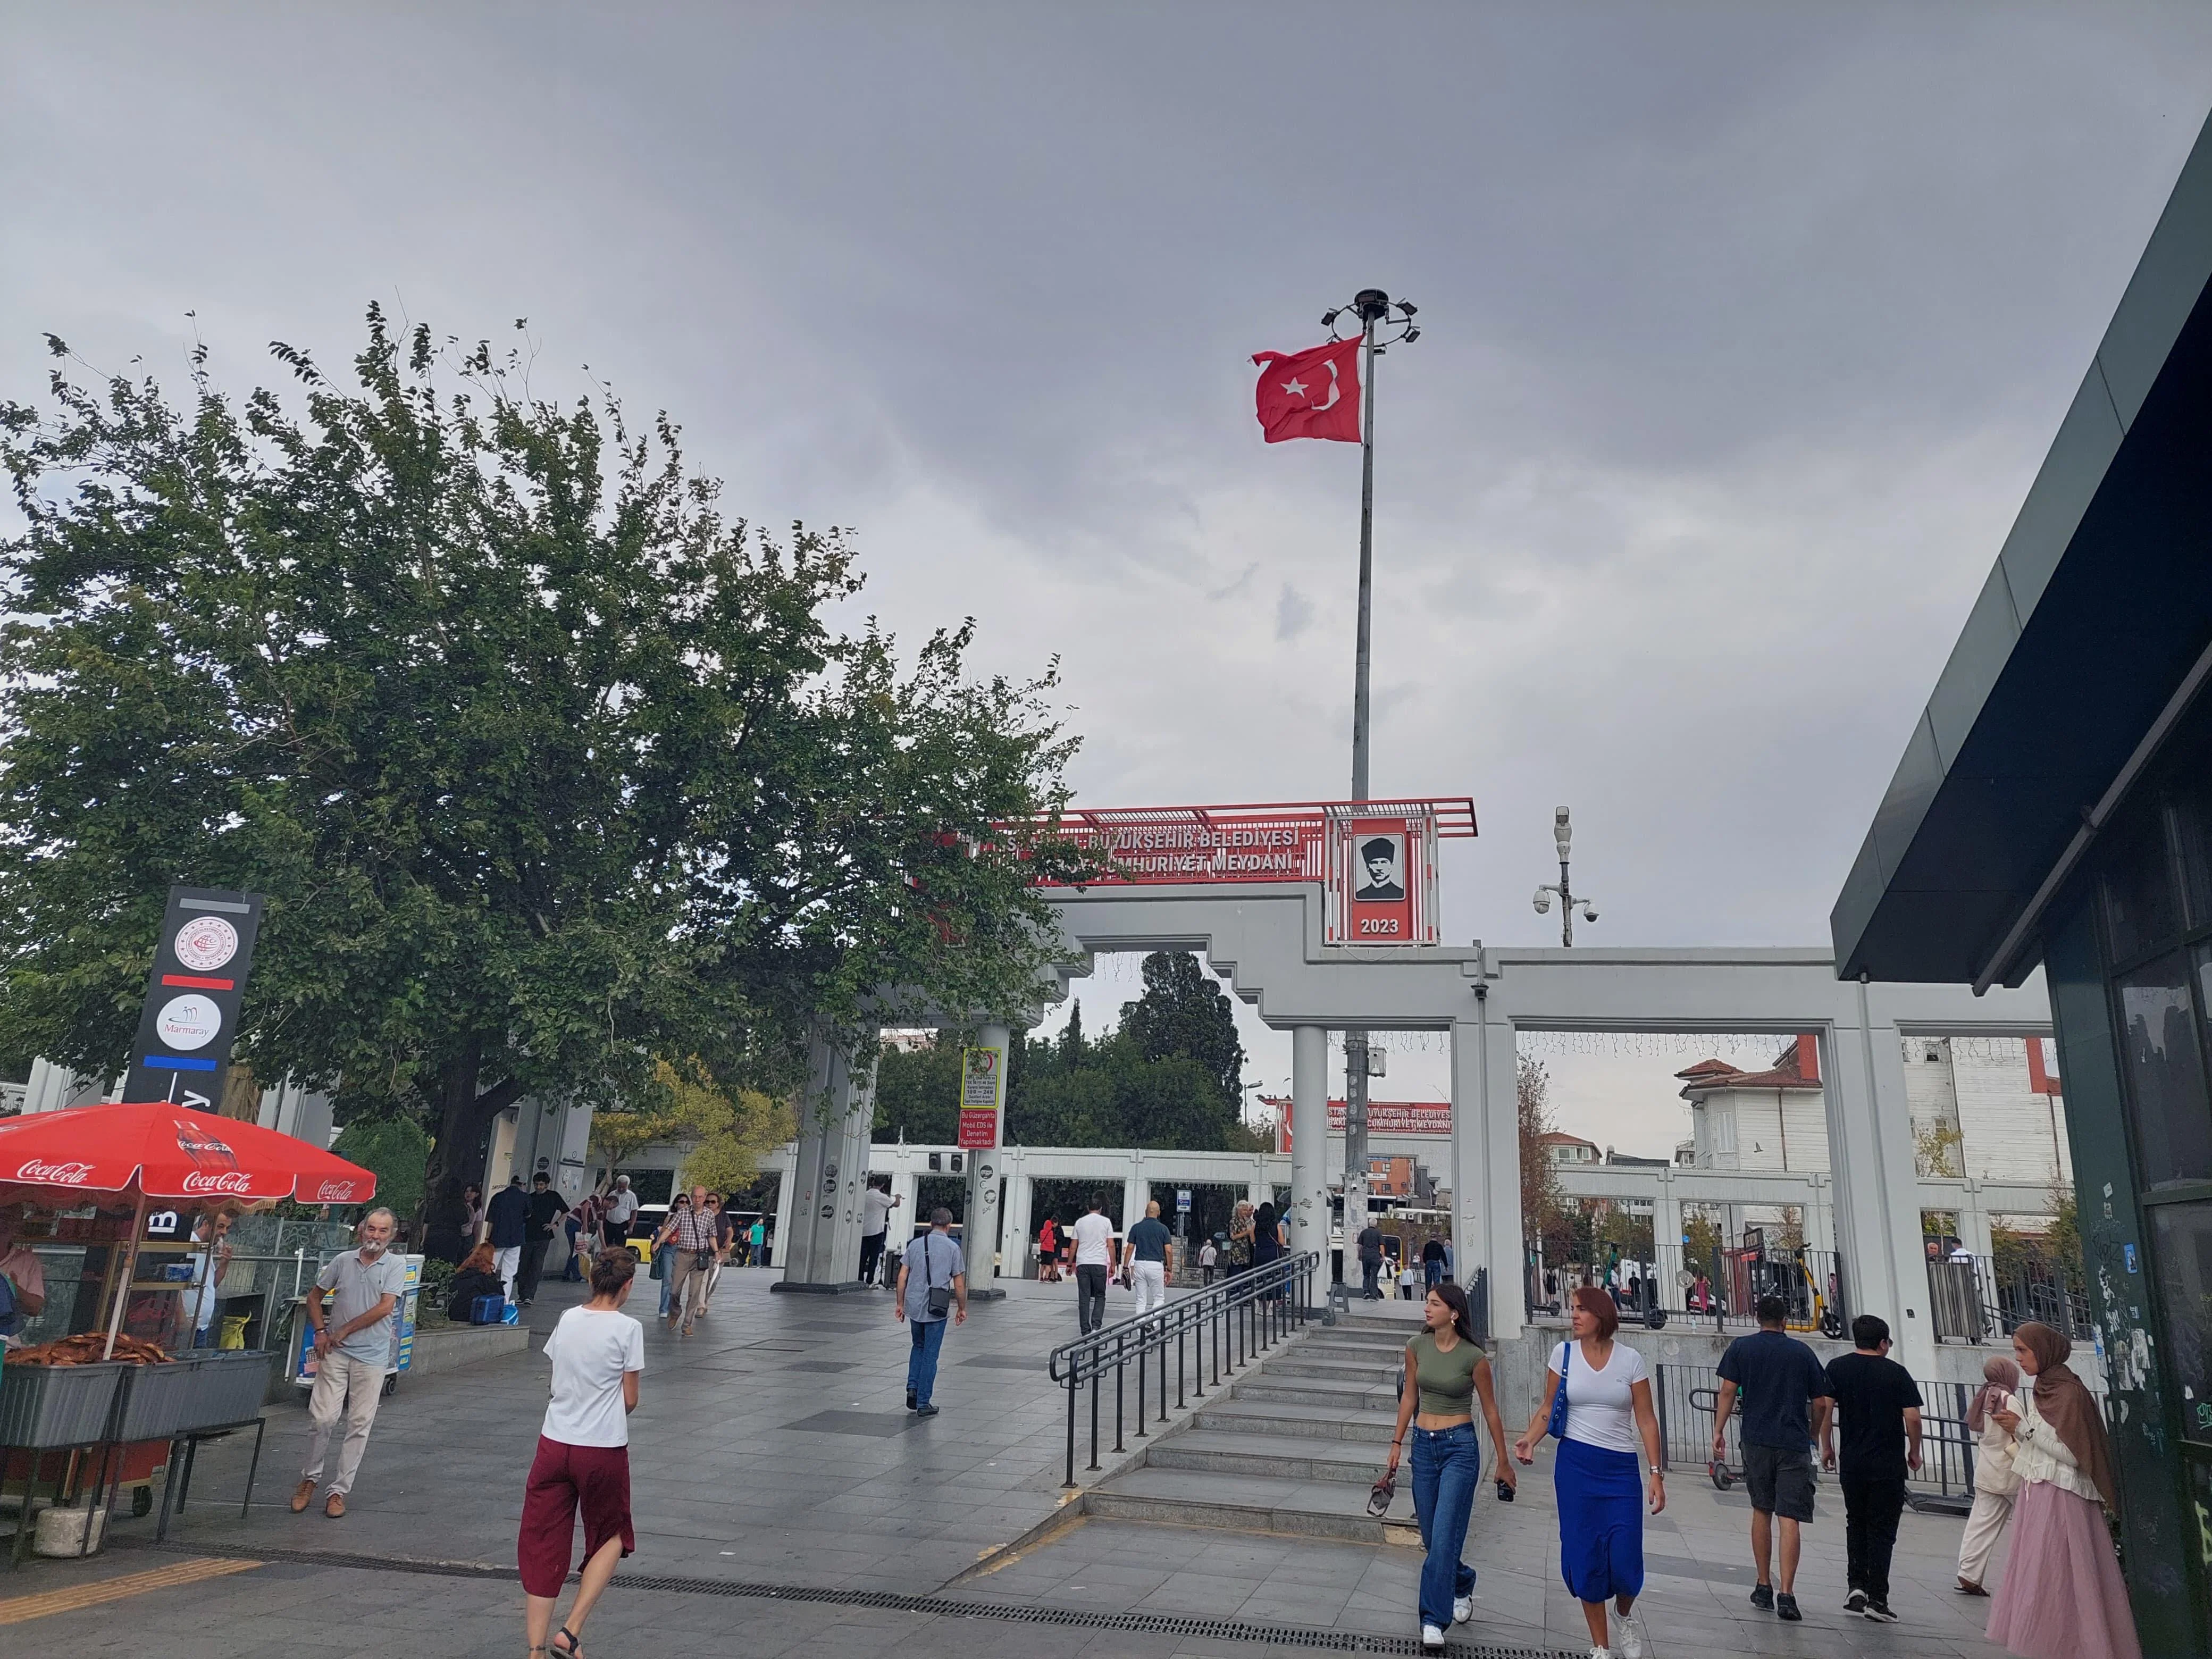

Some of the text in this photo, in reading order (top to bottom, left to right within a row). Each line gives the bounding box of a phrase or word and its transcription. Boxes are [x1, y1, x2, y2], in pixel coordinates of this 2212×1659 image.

[1088, 830, 1193, 852] BÜYÜKŞEHİR
[1200, 826, 1298, 847] BELEDİYESİ
[1361, 918, 1398, 933] 2023
[164, 1024, 210, 1038] Marmaray
[1411, 1110, 1451, 1119] BELEDİYES
